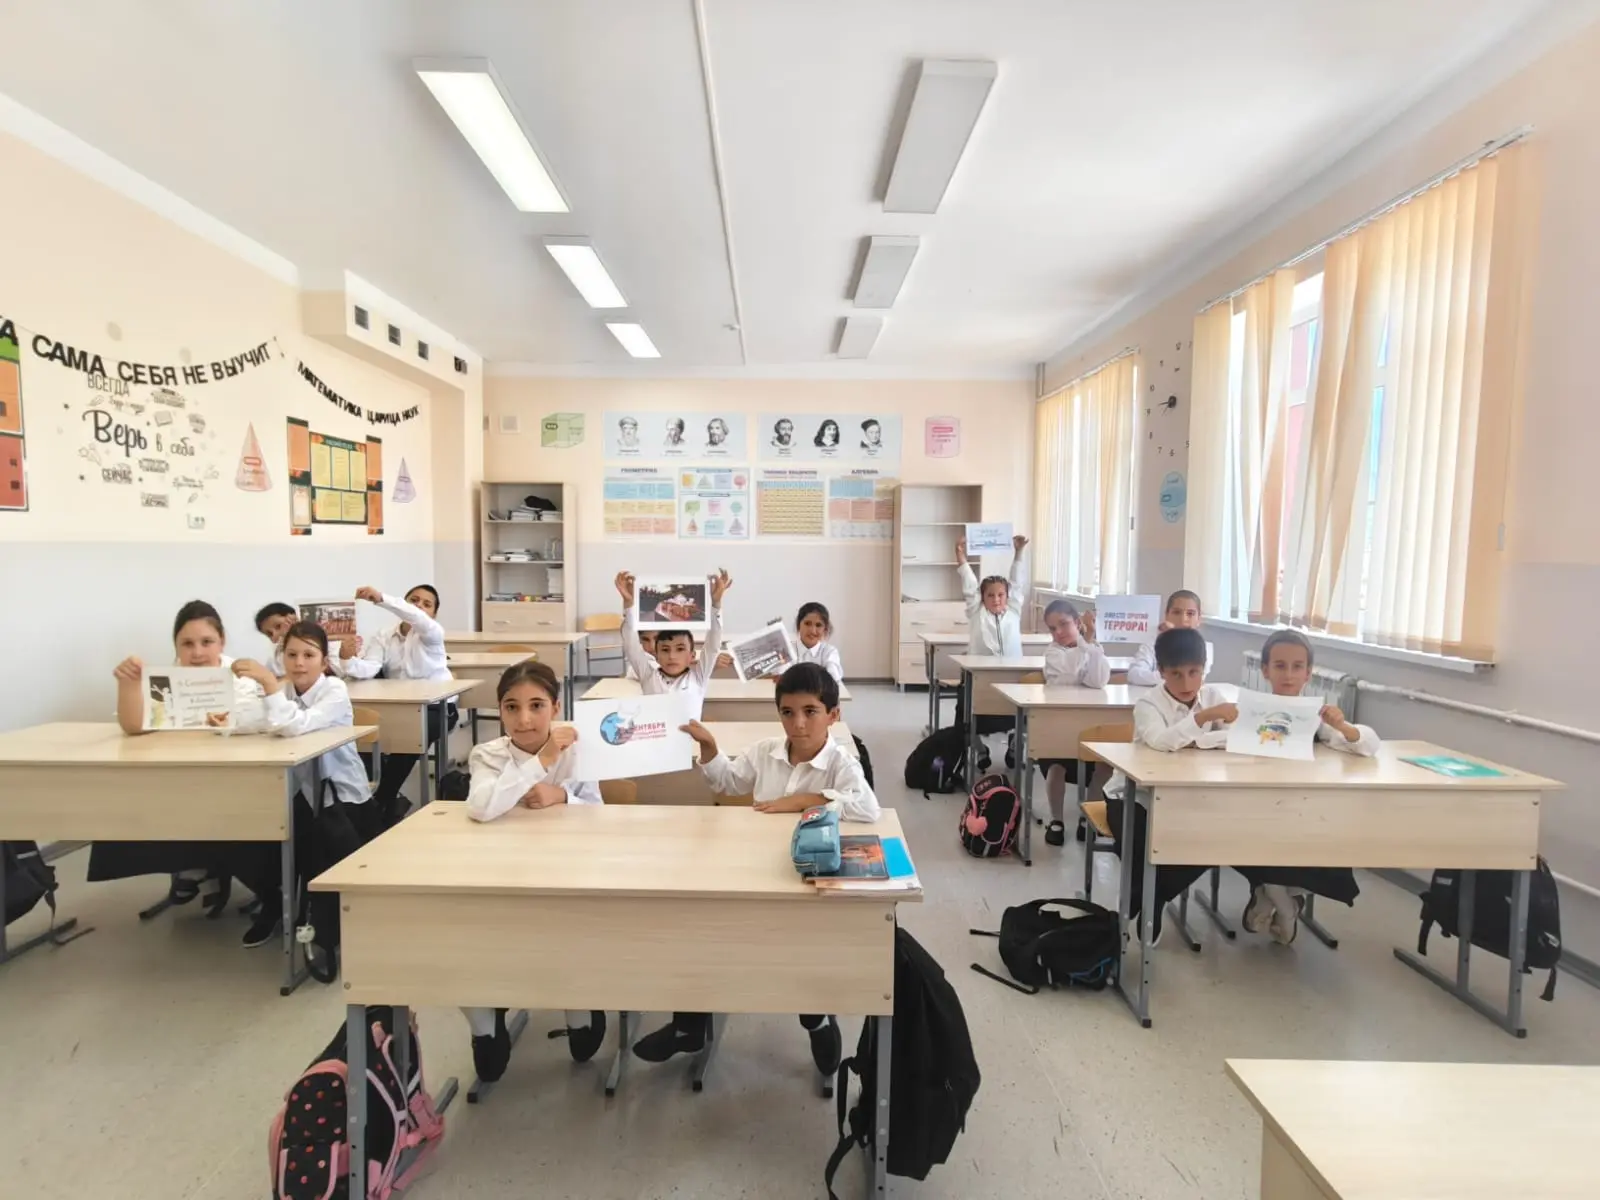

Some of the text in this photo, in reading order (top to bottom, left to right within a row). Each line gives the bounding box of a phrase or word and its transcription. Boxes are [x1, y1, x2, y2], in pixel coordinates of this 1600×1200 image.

[32, 334, 107, 378] САМА
[117, 361, 178, 386] СЕБЯ
[182, 364, 208, 385] НЕ
[211, 341, 271, 380] ВЫУЧИТ
[298, 361, 362, 417] МАТЕМАТИКА
[81, 409, 148, 458] Верь
[1104, 620, 1148, 632] ТЕРРОРА!
